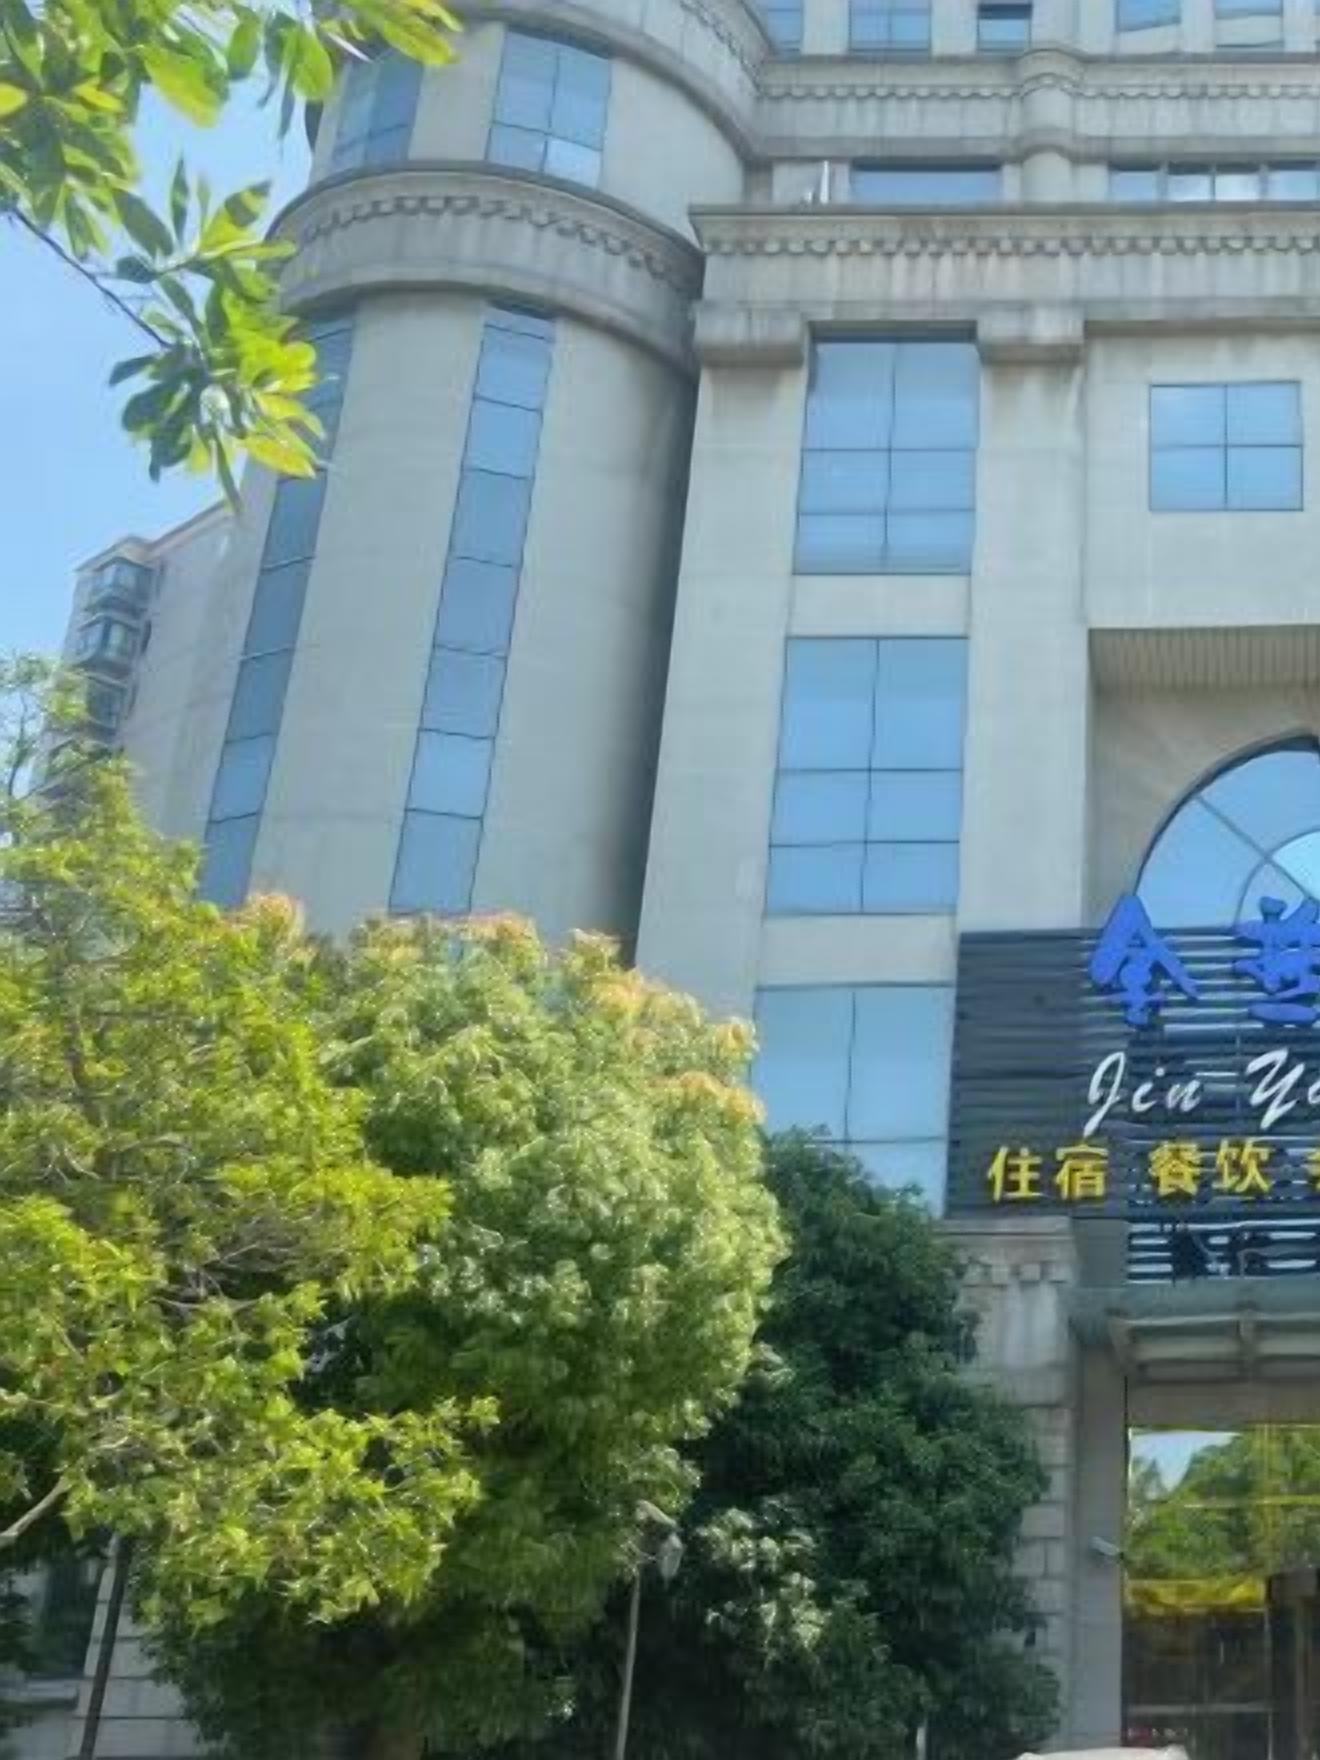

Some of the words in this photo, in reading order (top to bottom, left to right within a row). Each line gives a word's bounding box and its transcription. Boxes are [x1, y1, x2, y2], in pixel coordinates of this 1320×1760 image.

[1083, 1050, 1201, 1138] Jin
[988, 1144, 1109, 1200] 住宿
[1149, 1139, 1272, 1197] 餐饮
